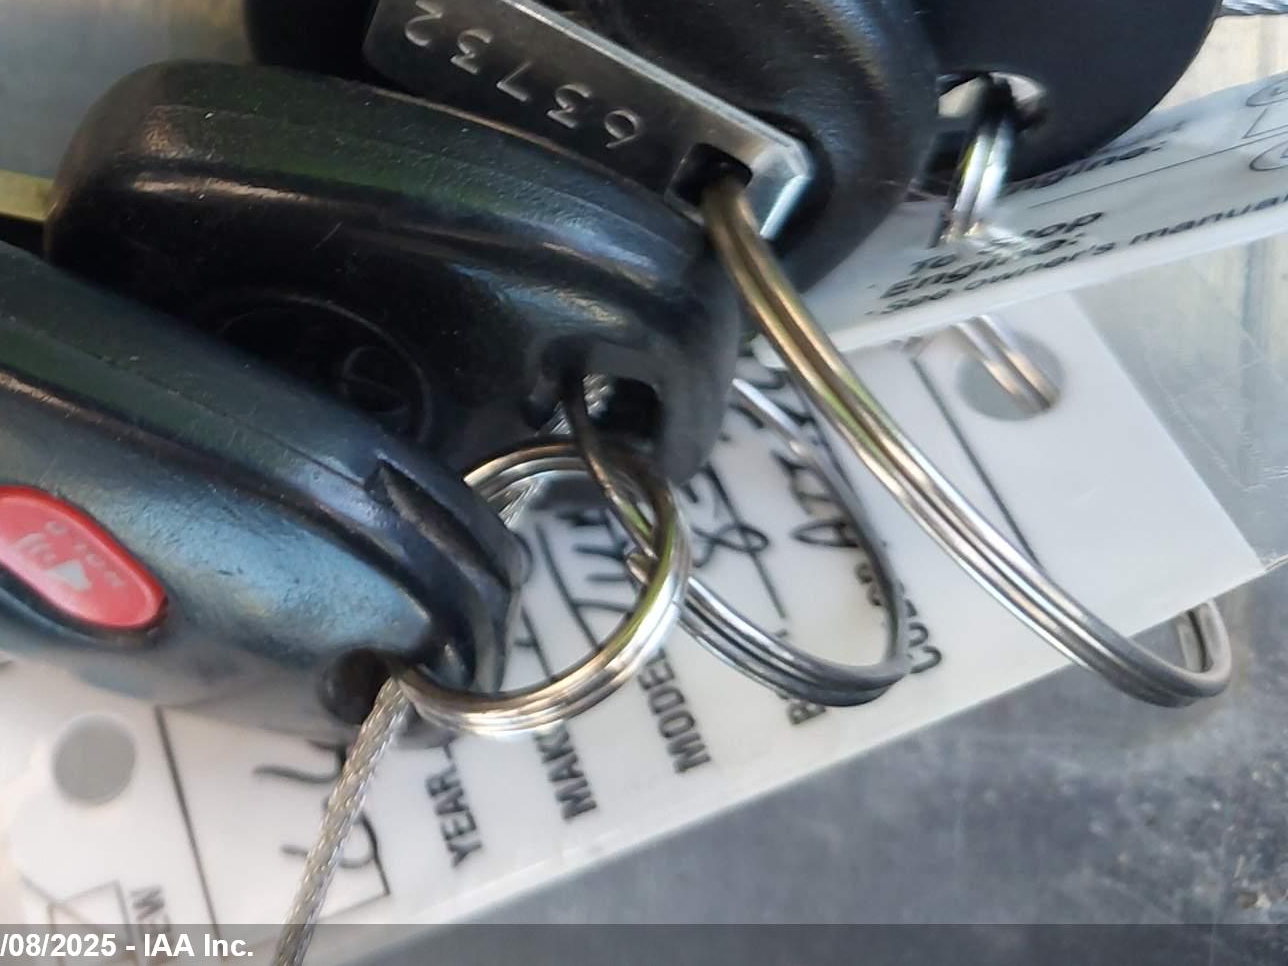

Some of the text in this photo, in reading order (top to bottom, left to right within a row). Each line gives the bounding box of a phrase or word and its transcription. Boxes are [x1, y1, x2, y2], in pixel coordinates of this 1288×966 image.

[879, 232, 1085, 299] Engie:
[964, 243, 1116, 291] owner's
[1129, 195, 1288, 246] manua
[425, 763, 483, 868] YEAR
[531, 719, 598, 821] MAK
